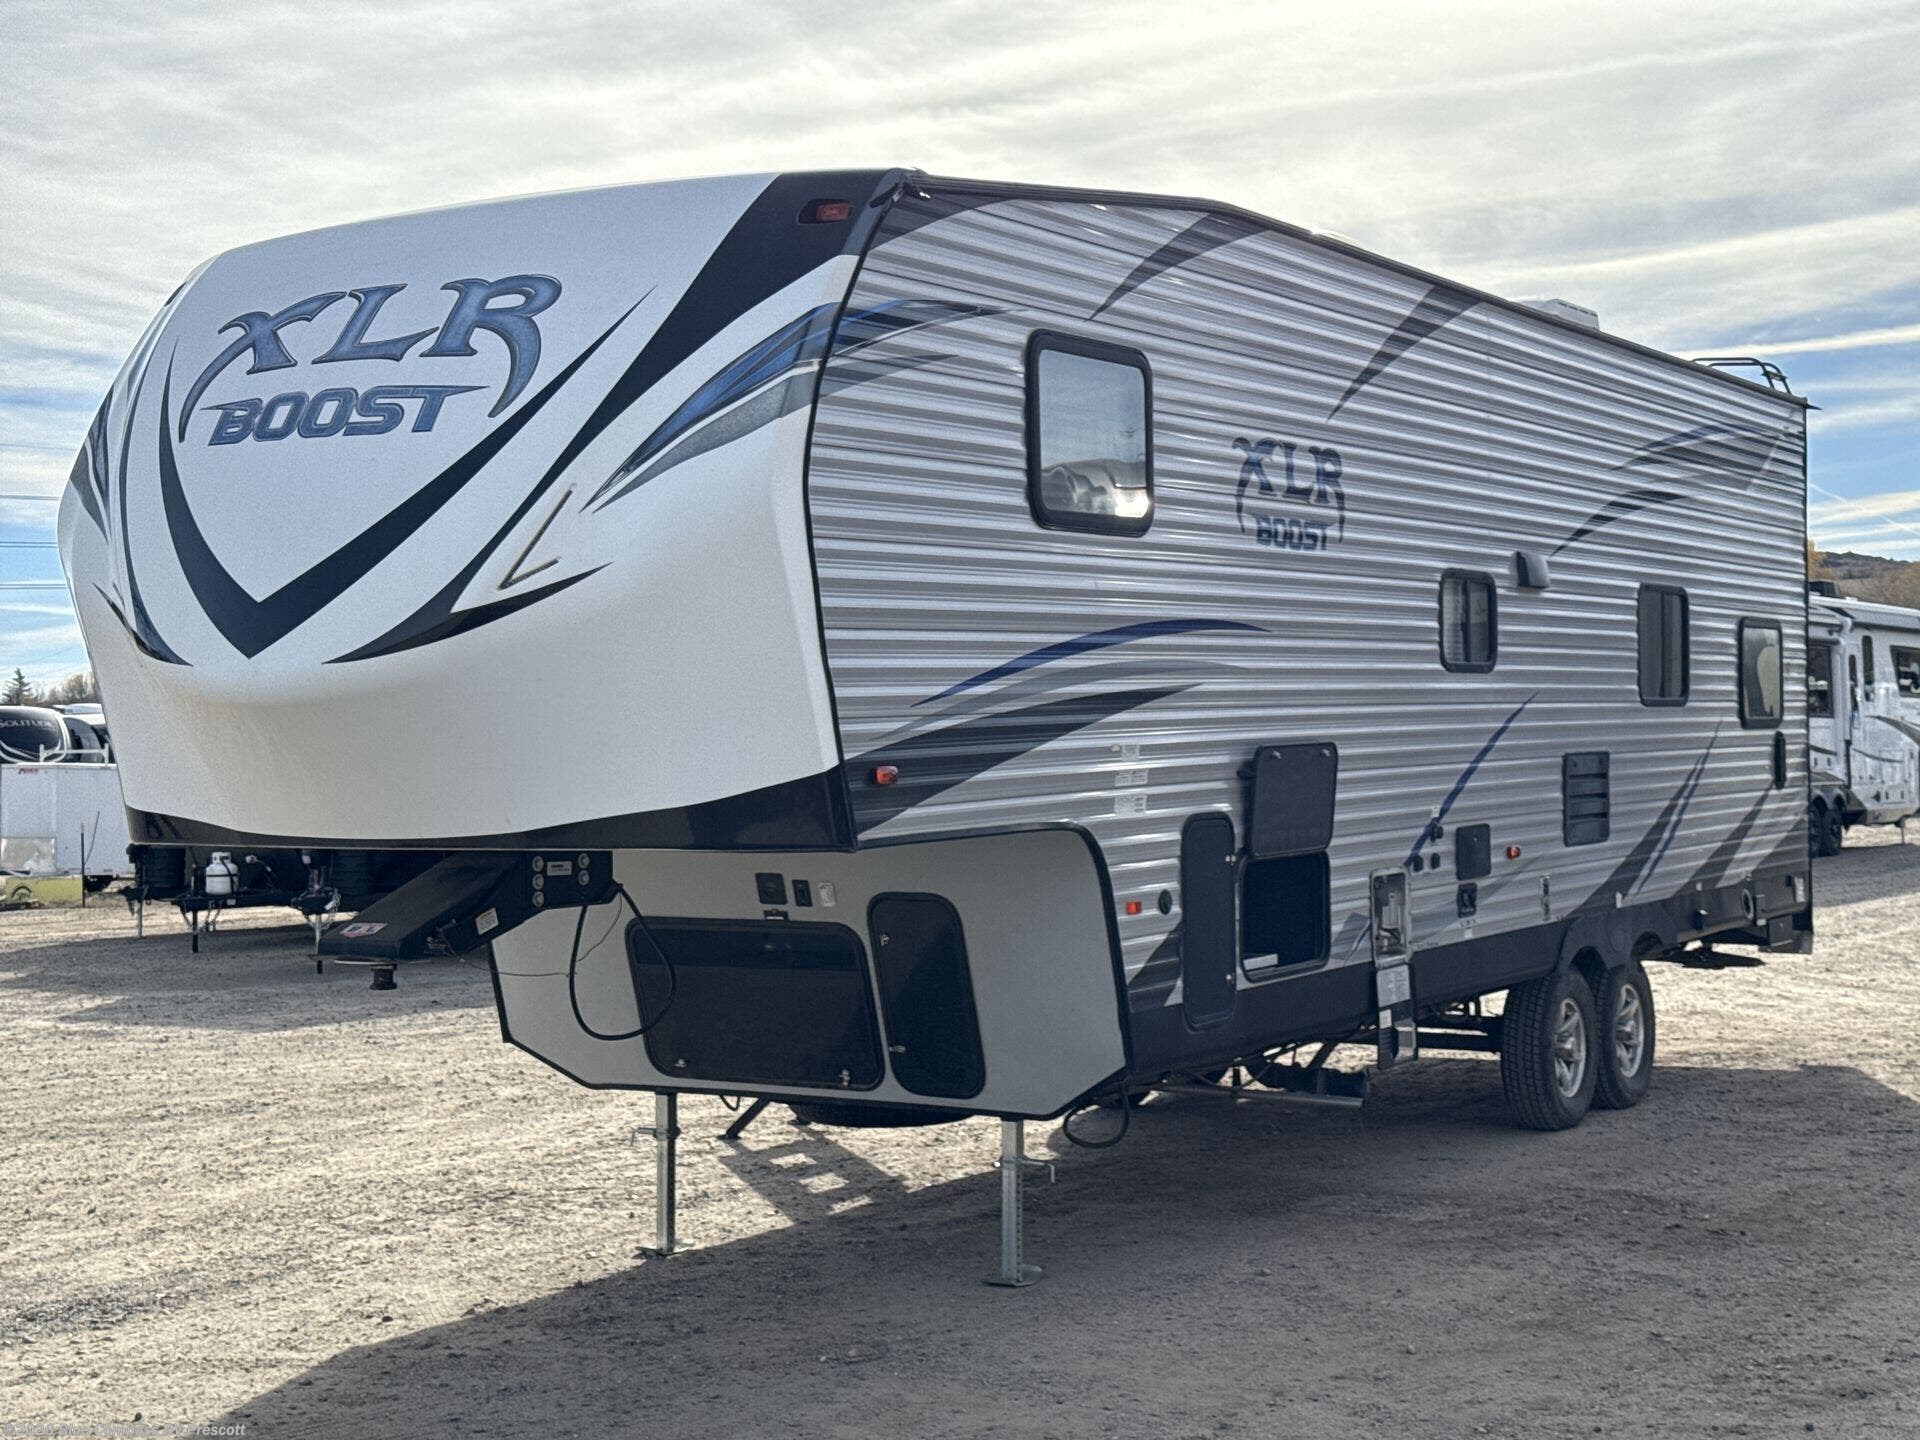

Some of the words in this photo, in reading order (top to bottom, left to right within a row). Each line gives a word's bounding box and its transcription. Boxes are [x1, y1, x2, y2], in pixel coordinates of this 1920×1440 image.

[179, 274, 562, 443] XLR
[200, 384, 491, 446] BOOST
[1232, 437, 1345, 543] XLR
[1253, 513, 1335, 550] BOOST
